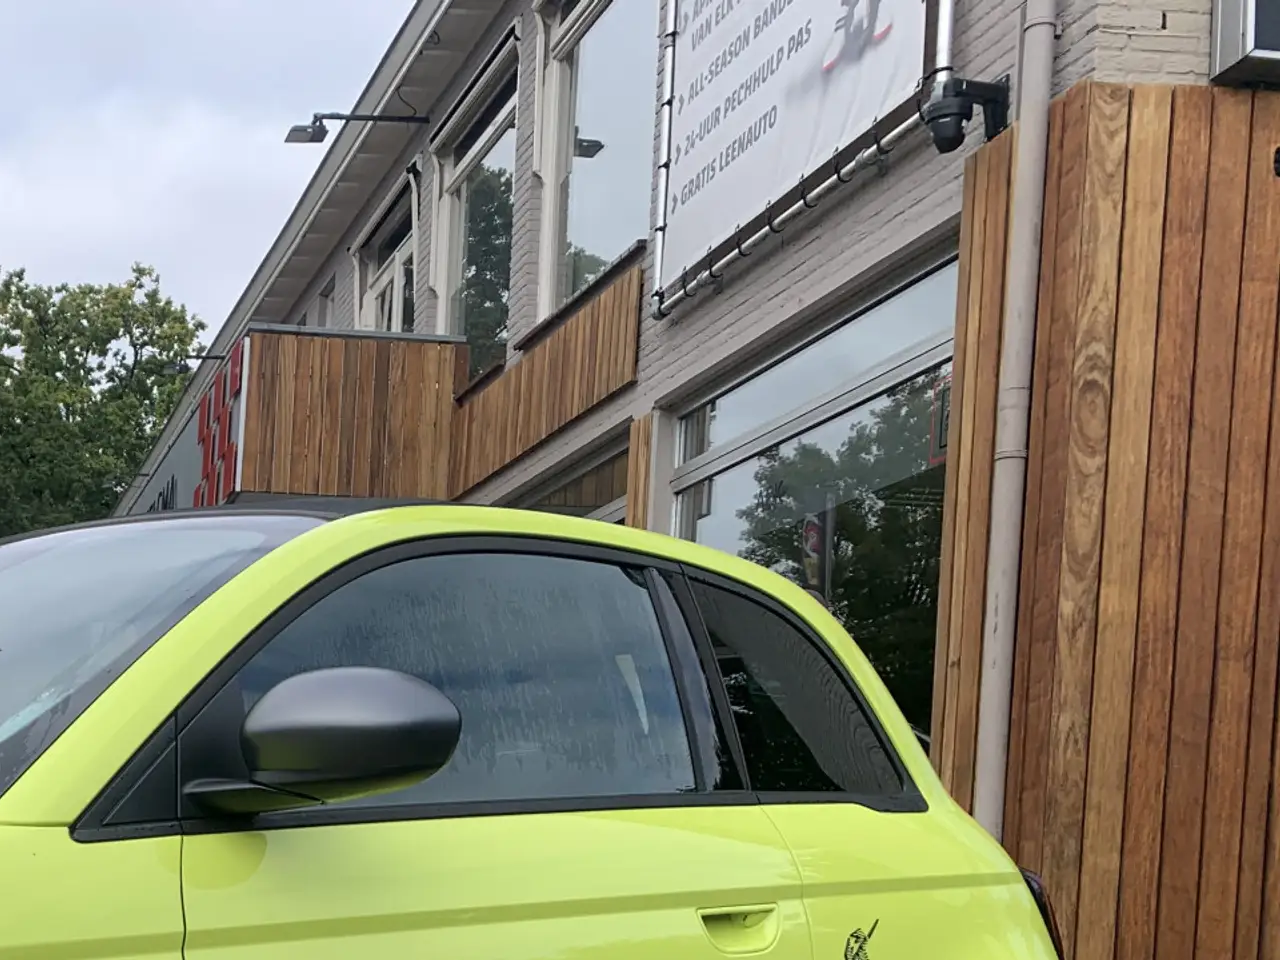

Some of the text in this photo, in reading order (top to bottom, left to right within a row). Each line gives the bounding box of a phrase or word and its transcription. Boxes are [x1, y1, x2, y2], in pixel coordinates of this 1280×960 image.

[687, 0, 794, 105] ALL-SEASON BAND
[691, 13, 712, 51] VAN
[684, 18, 812, 156] 24-UUR PECHHULP PAS
[680, 104, 778, 206] GRATIS LEENAUTO
